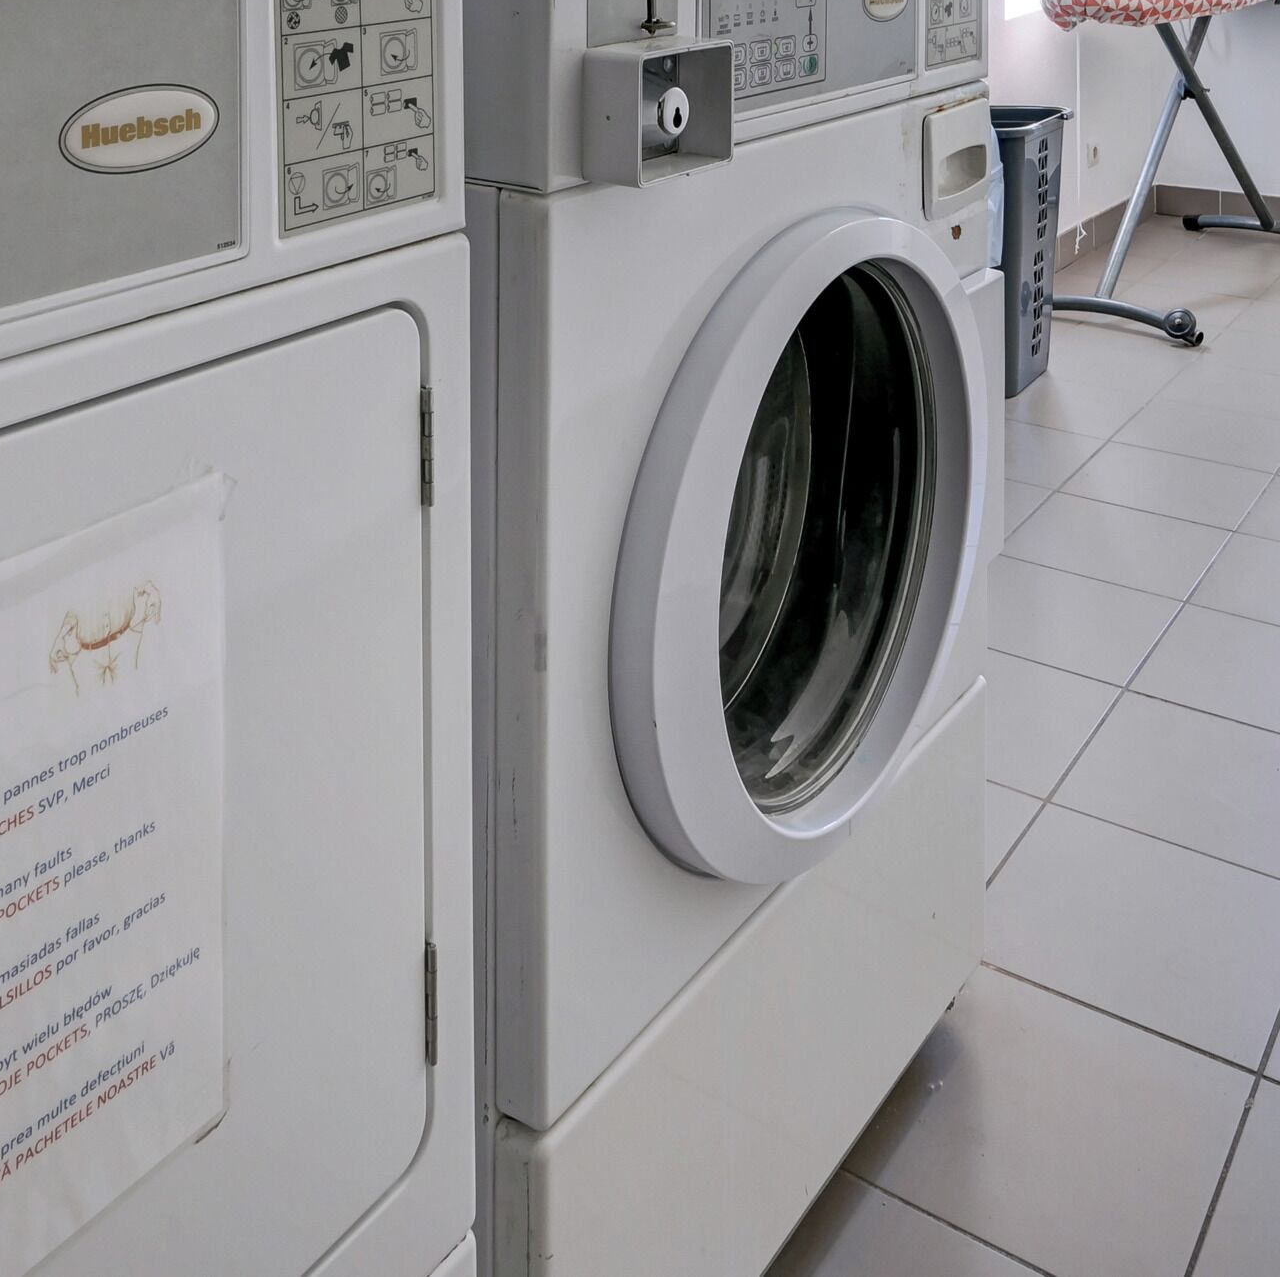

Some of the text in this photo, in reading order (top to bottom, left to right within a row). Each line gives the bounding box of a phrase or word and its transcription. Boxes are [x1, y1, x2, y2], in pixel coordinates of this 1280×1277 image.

[80, 108, 201, 150] Huebsch
[3, 765, 54, 805] pannes
[59, 749, 86, 773] trop
[90, 705, 169, 755] nombreuses
[38, 789, 68, 814] SVP,
[72, 763, 110, 795] Merci
[34, 847, 72, 877] faults
[64, 851, 110, 886] please,
[114, 820, 156, 853] thanks
[56, 950, 78, 975] por
[83, 925, 119, 954] favor,
[124, 892, 166, 930] gracias
[66, 913, 100, 943] fallas
[22, 1023, 59, 1055] wielu
[26, 1024, 91, 1077] POCKETS,
[1, 1127, 33, 1159] prea
[38, 1094, 77, 1131] multe
[16, 1101, 93, 1170] PACHETELE
[97, 1055, 156, 1109] NOASTRE
